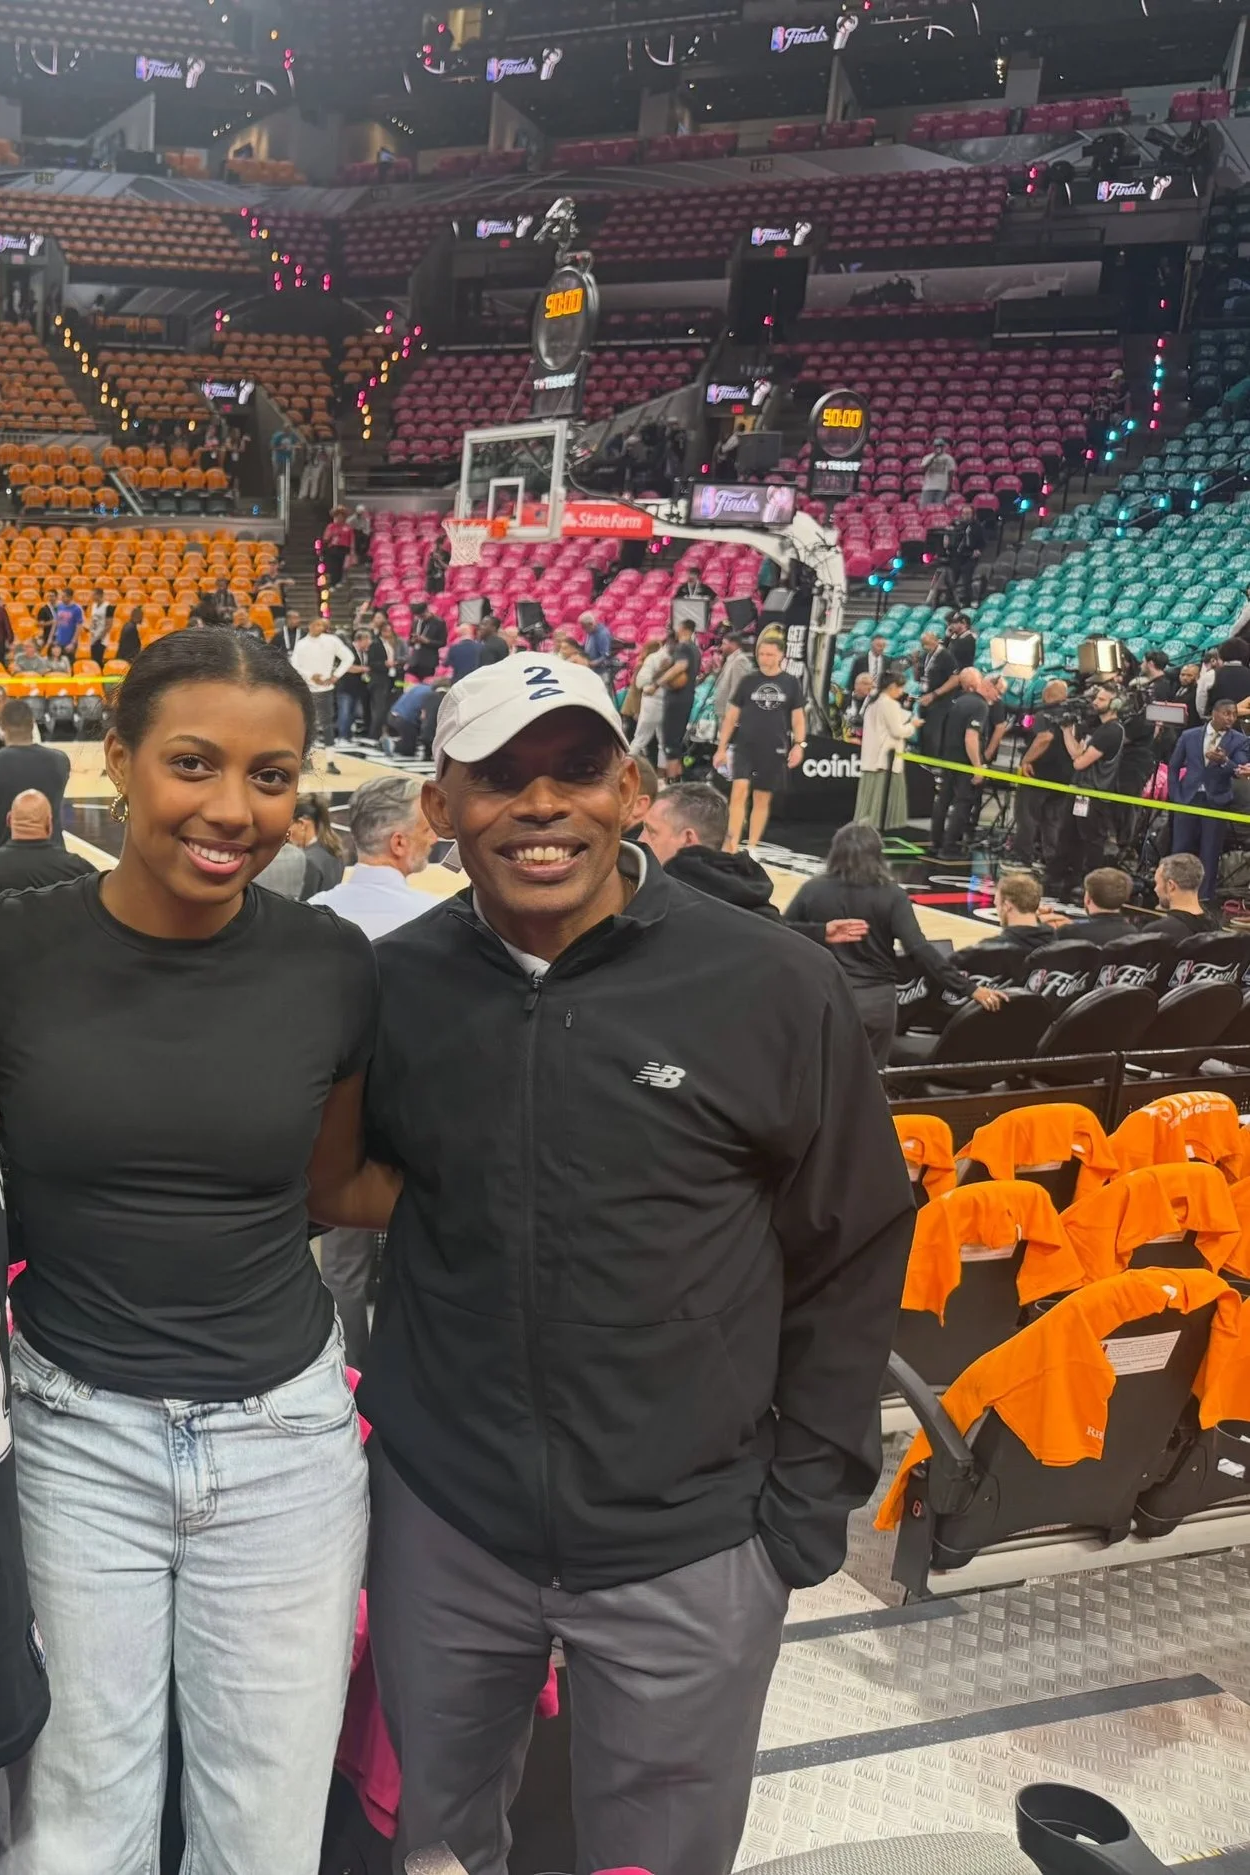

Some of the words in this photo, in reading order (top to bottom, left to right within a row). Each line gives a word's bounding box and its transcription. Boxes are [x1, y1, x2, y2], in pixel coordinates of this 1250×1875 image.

[778, 25, 829, 53] Finals
[1103, 182, 1146, 202] Finals
[823, 408, 863, 428] 90:00
[712, 489, 759, 519] Finals
[895, 976, 928, 1005] nals
